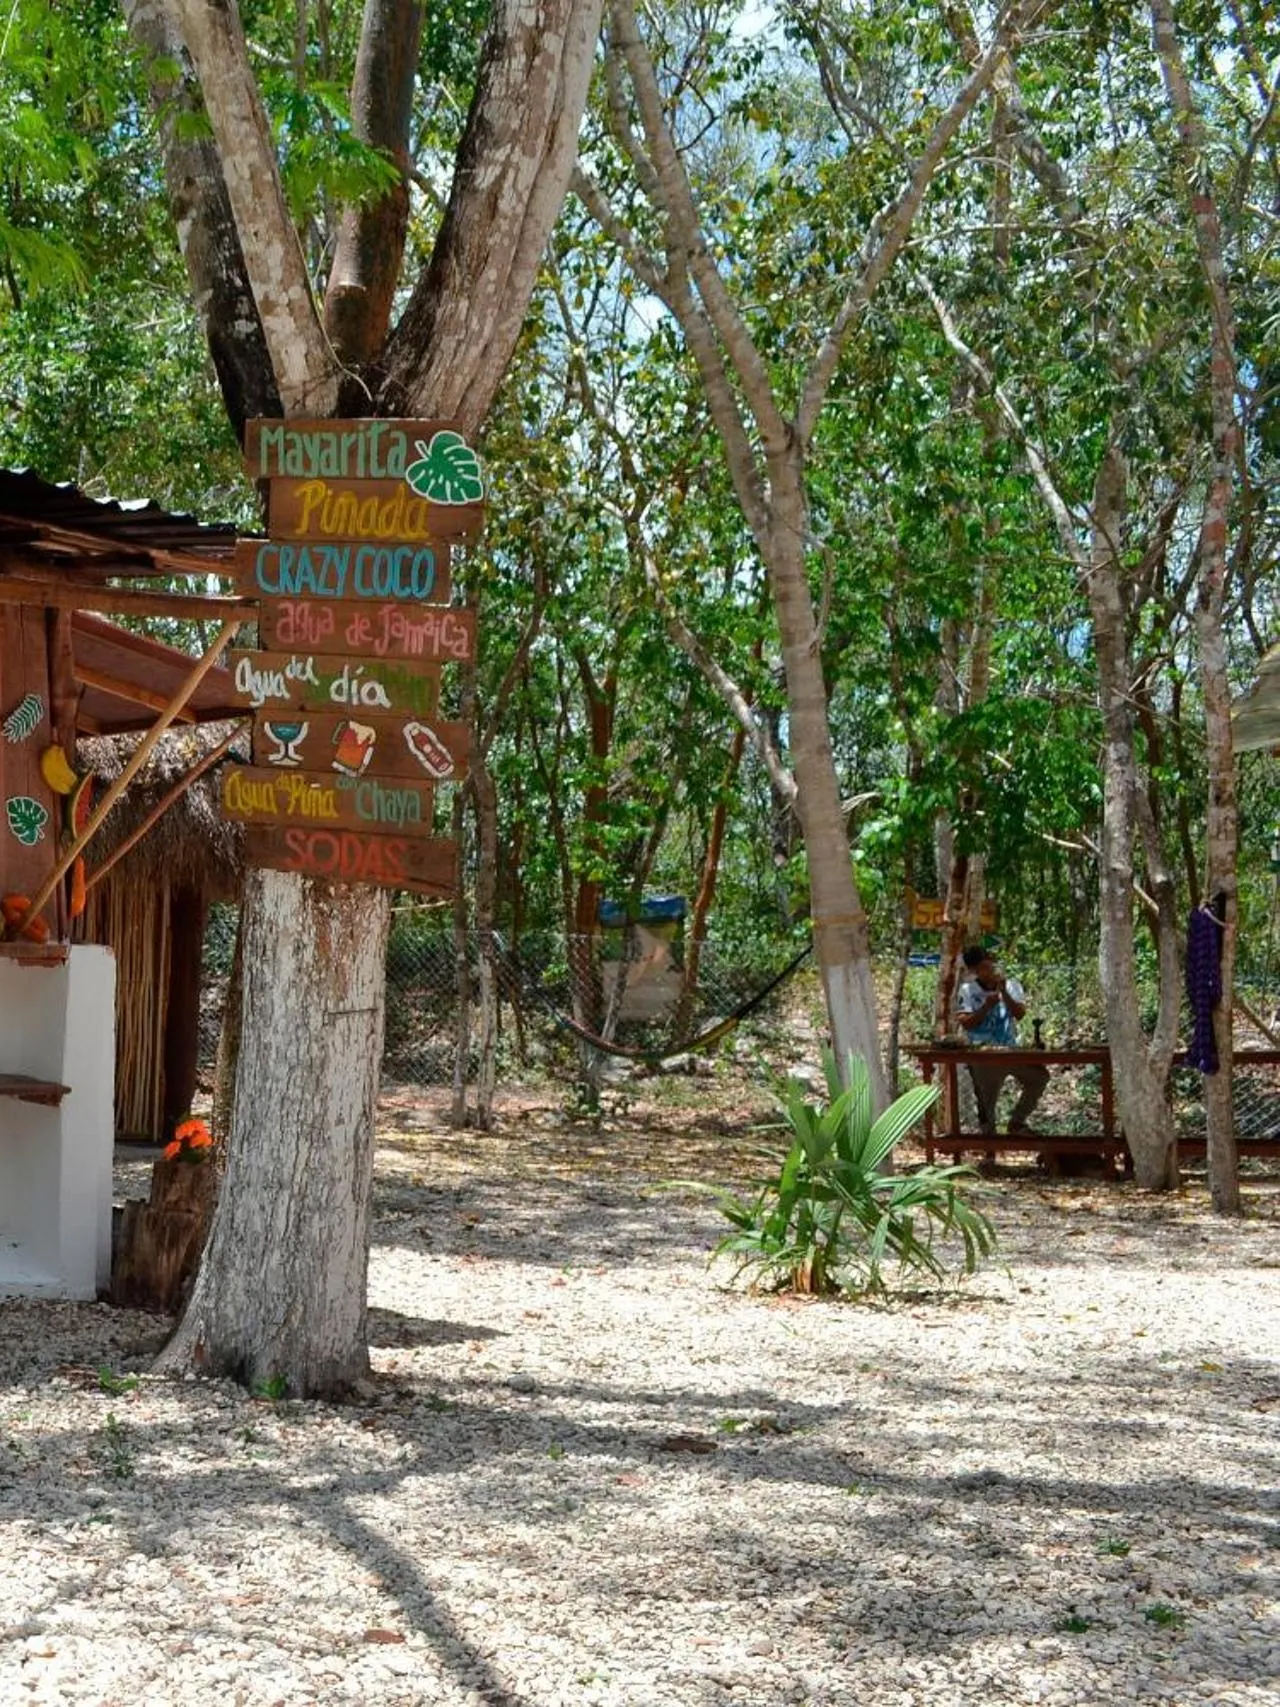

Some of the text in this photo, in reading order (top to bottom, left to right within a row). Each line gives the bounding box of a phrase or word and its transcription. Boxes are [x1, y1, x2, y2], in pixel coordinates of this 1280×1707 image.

[256, 544, 435, 598] CRAZY COCO
[345, 612, 371, 646] de
[374, 604, 470, 658] Jamaica
[285, 655, 320, 686] del
[330, 664, 392, 708] día
[356, 781, 420, 828] Chaya
[284, 829, 408, 884] SODAS
